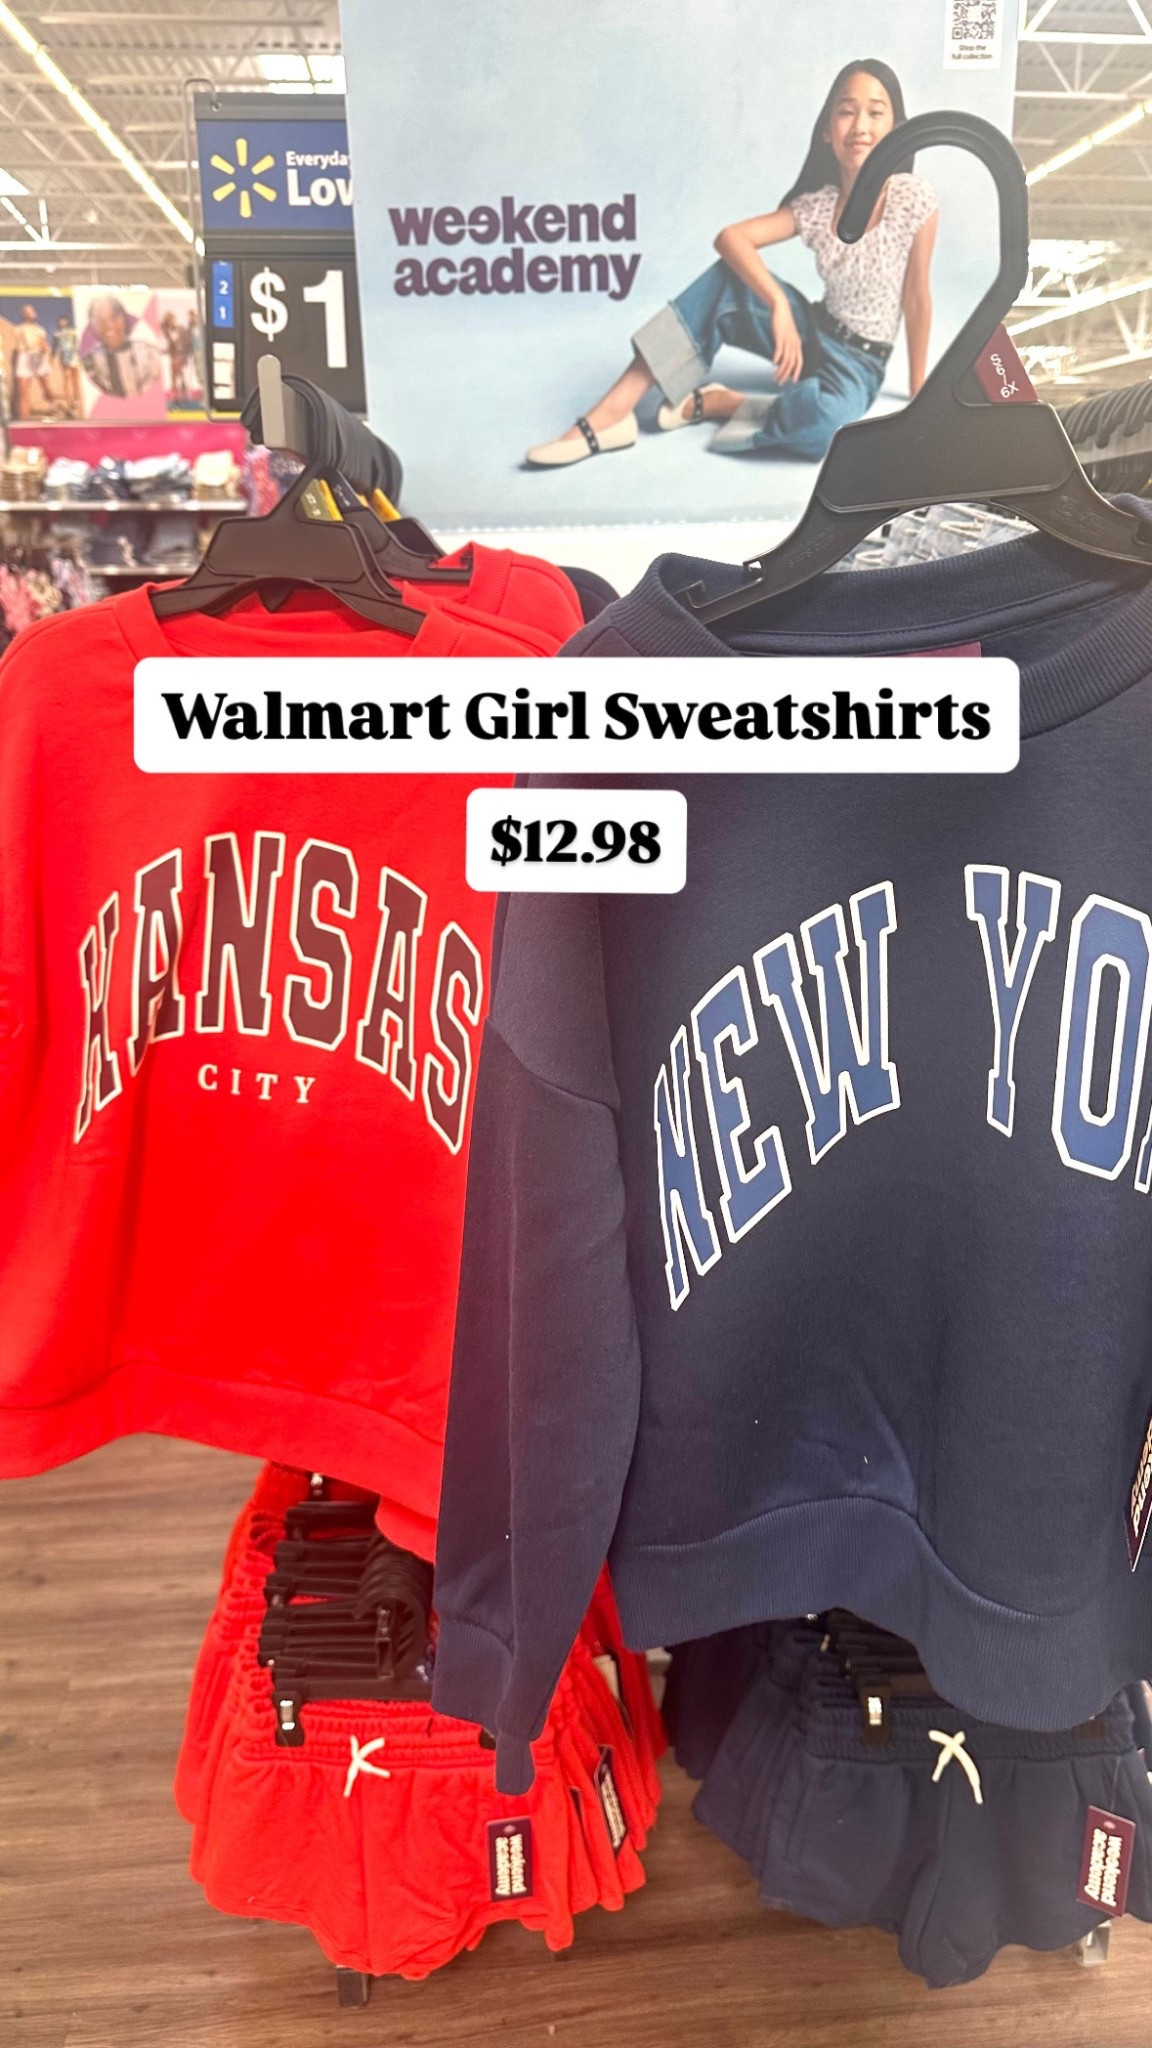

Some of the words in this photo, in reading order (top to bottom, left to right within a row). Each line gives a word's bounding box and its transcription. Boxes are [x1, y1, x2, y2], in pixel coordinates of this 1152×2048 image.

[285, 150, 350, 171] Everyda
[387, 193, 637, 247] weekend
[218, 280, 229, 295] 2
[393, 247, 642, 301] academy
[219, 306, 227, 320] 1
[75, 831, 483, 1155] KANSAS
[198, 1063, 316, 1104] CITY
[654, 880, 900, 1311] NEW
[964, 863, 1152, 1194] YO
